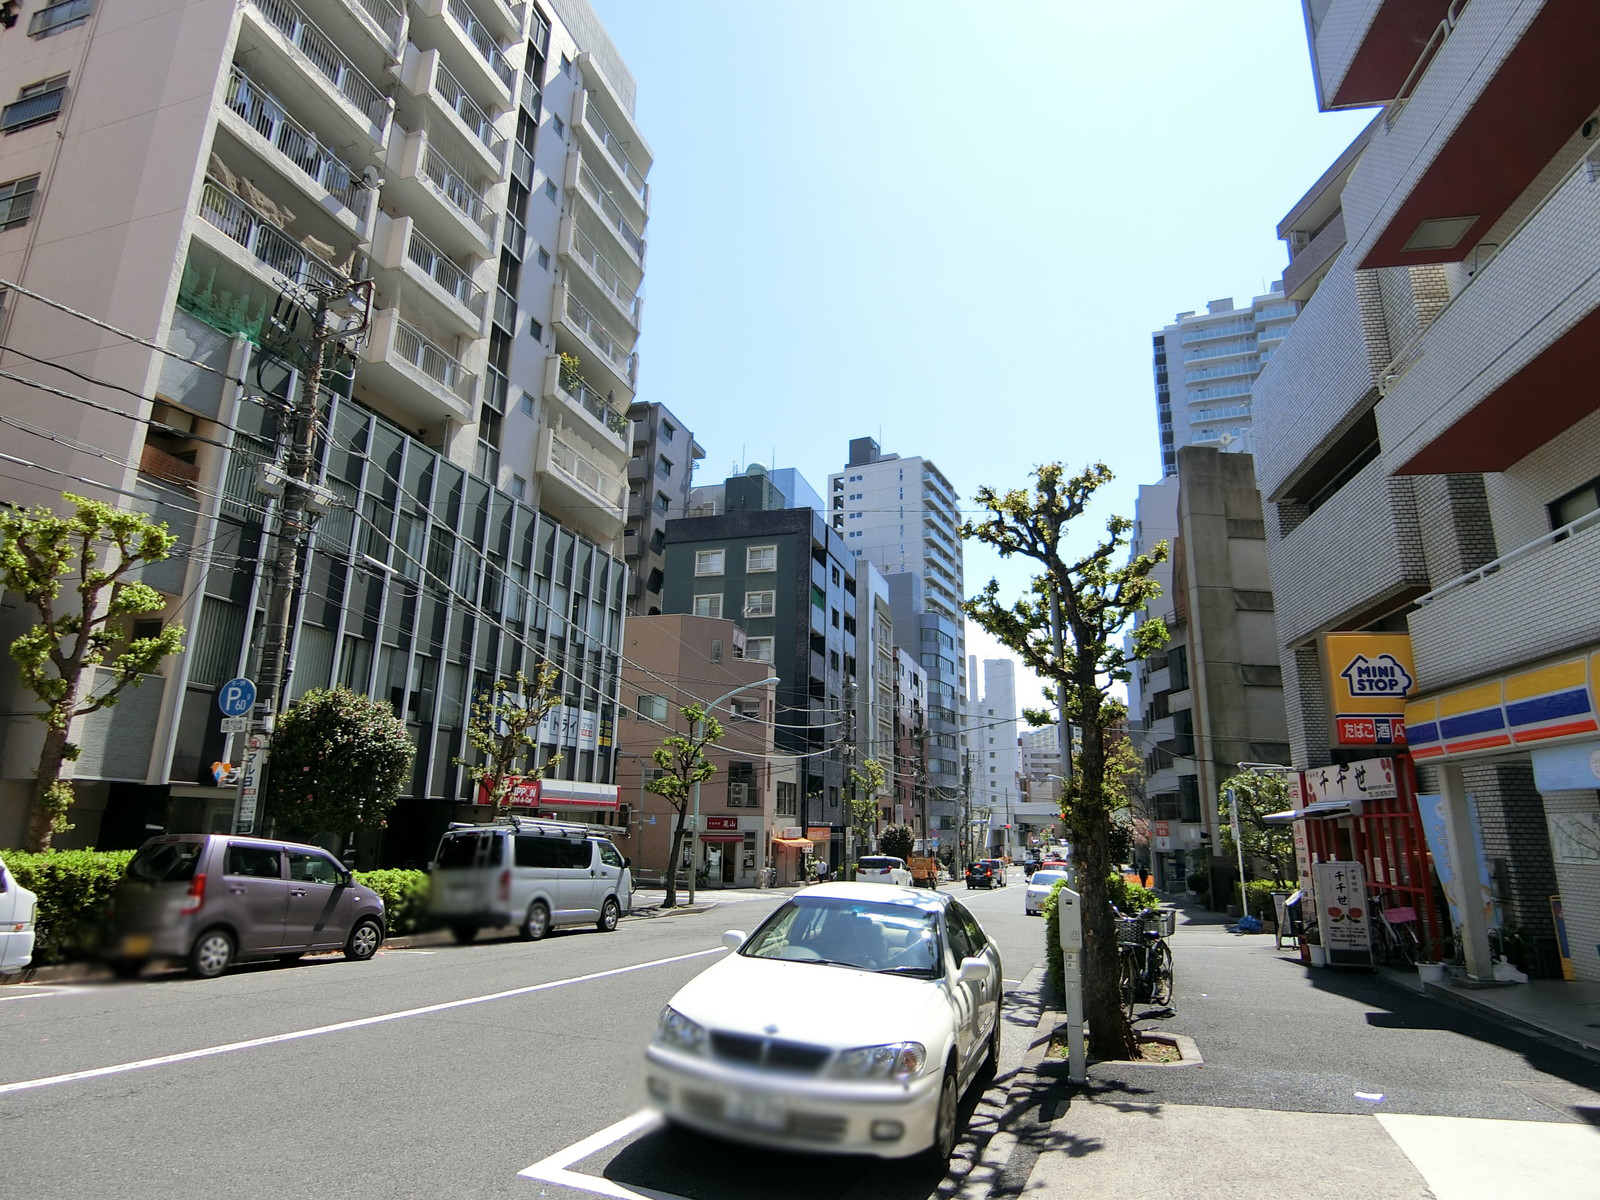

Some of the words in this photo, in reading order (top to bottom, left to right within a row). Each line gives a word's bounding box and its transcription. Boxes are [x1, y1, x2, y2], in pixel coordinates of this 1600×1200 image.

[1357, 666, 1395, 678] MINI
[1357, 679, 1399, 691] STOP
[226, 687, 242, 711] P
[235, 700, 247, 710] 60
[1344, 722, 1374, 738] たばこ
[1376, 723, 1391, 738] 酒
[1334, 870, 1348, 905] 千千世
